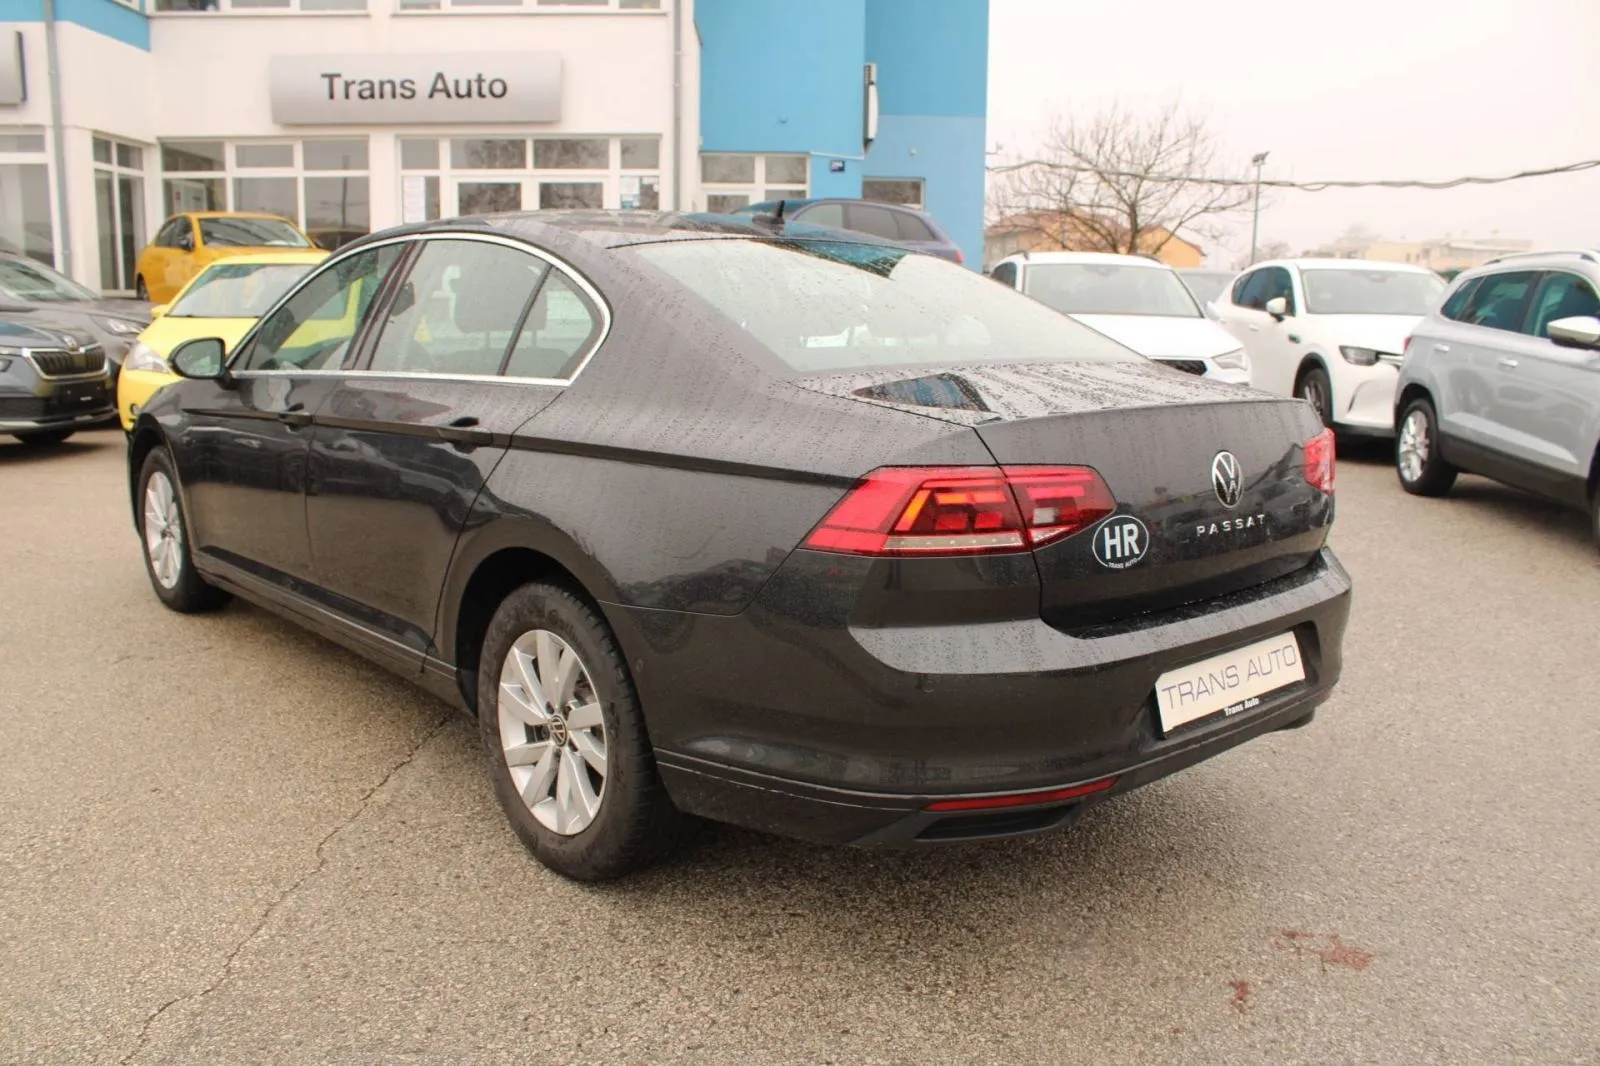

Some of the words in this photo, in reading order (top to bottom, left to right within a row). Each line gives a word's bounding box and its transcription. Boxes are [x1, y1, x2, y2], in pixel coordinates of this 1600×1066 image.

[320, 73, 417, 100] Trans
[428, 72, 508, 99] Auto
[1196, 514, 1265, 537] PASSAT
[1103, 523, 1141, 560] HR
[1161, 664, 1240, 710] TRANS
[1247, 644, 1297, 682] AUTO
[1223, 702, 1244, 717] Trans
[1244, 697, 1260, 709] Auto
